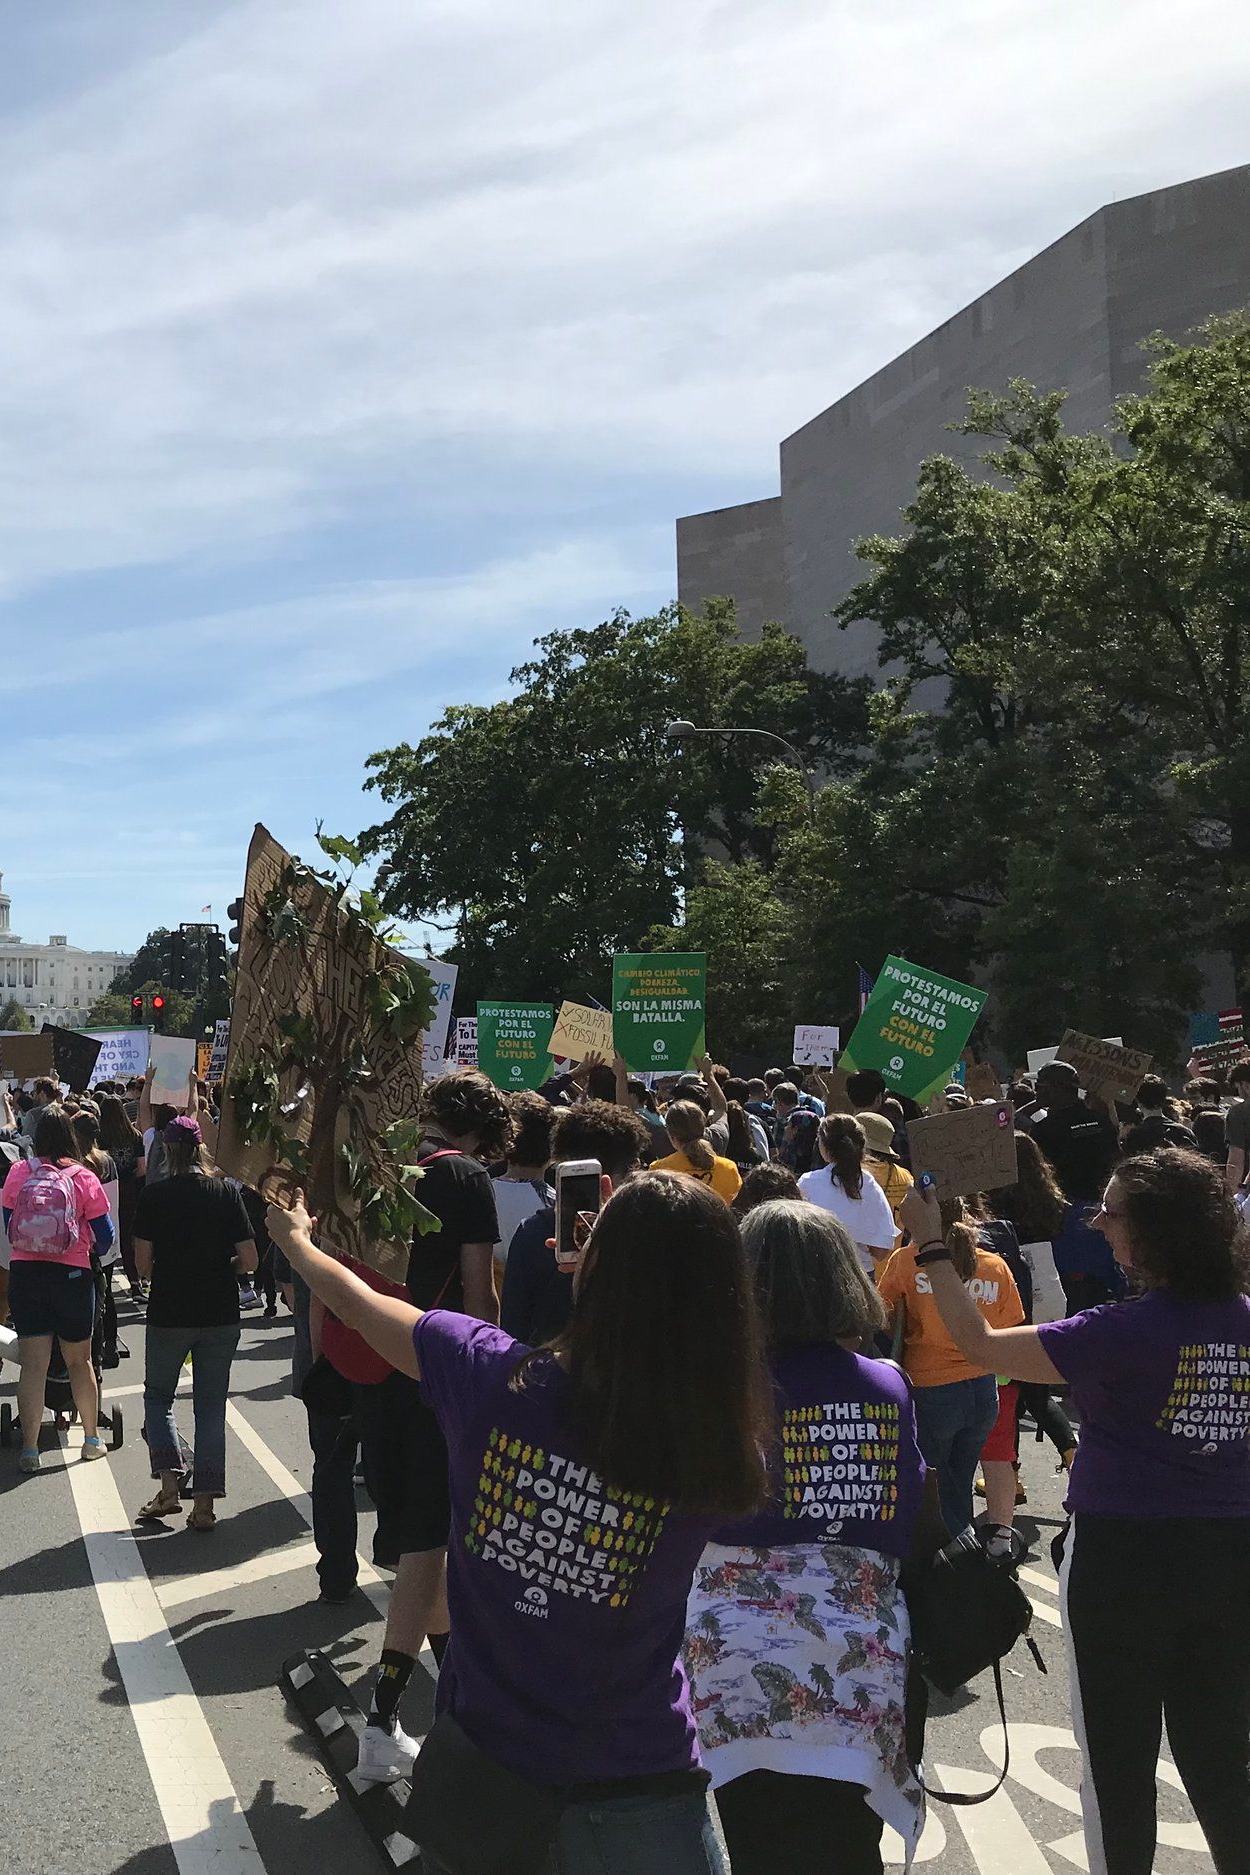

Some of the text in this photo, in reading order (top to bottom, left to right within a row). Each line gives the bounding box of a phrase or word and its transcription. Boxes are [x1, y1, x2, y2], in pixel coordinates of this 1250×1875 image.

[618, 969, 652, 977] CAMBIO
[884, 965, 980, 1013] PROTESTAMOS
[616, 1000, 702, 1012] SON LA MISMA
[902, 989, 946, 1016] POR EL
[479, 1008, 551, 1019] PROTESTAMOS
[571, 1008, 606, 1030] SOLAR
[633, 1012, 685, 1023] BATALLA.
[892, 1000, 947, 1031] FUTURO
[498, 1019, 532, 1029] POR EL
[889, 1015, 935, 1044] CON EL
[459, 1029, 469, 1039] To
[495, 1030, 536, 1039] FUTURO
[568, 1023, 597, 1047] FOSSIL
[802, 1030, 823, 1040] For
[880, 1026, 934, 1057] FUTURO
[498, 1040, 534, 1049] CON EL
[495, 1050, 537, 1059] FUTURO
[881, 1068, 902, 1081] OXFAM
[1207, 1343, 1237, 1357] THE
[1197, 1360, 1250, 1376] POWER
[1209, 1376, 1229, 1391] OF
[1189, 1393, 1249, 1409] PEOPLE
[823, 1402, 861, 1420] THE
[1174, 1408, 1250, 1426] AGAINST
[808, 1423, 879, 1442] POWER
[1171, 1421, 1248, 1441] POVERTY
[832, 1444, 858, 1460] OF
[549, 1454, 603, 1495] THE
[810, 1464, 879, 1482] PEOPLE
[516, 1469, 620, 1527] POWER
[802, 1483, 883, 1502] AGAINST
[798, 1502, 881, 1520] POVERTY
[541, 1507, 581, 1536] OF
[503, 1512, 608, 1569] PEOPLE
[486, 1529, 615, 1589] AGAINST
[482, 1544, 610, 1604] POVERTY
[514, 1601, 549, 1619] OXFAM
